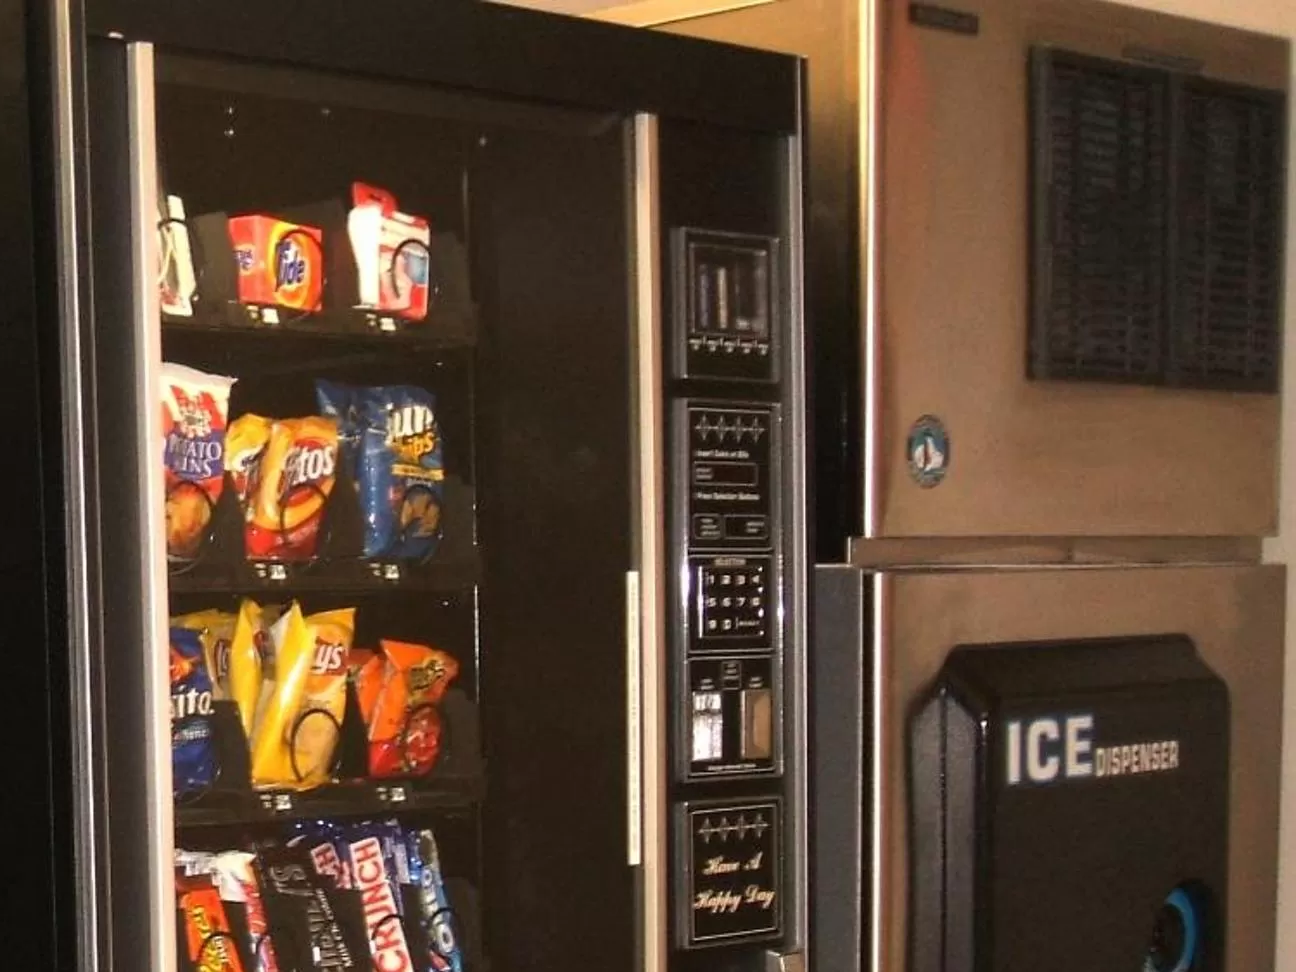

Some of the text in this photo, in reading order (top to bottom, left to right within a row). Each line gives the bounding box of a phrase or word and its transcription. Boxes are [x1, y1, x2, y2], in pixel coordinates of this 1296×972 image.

[1007, 715, 1179, 785] ICE DISPENSER
[702, 855, 740, 875] Have
[692, 884, 776, 914] Happy Day
